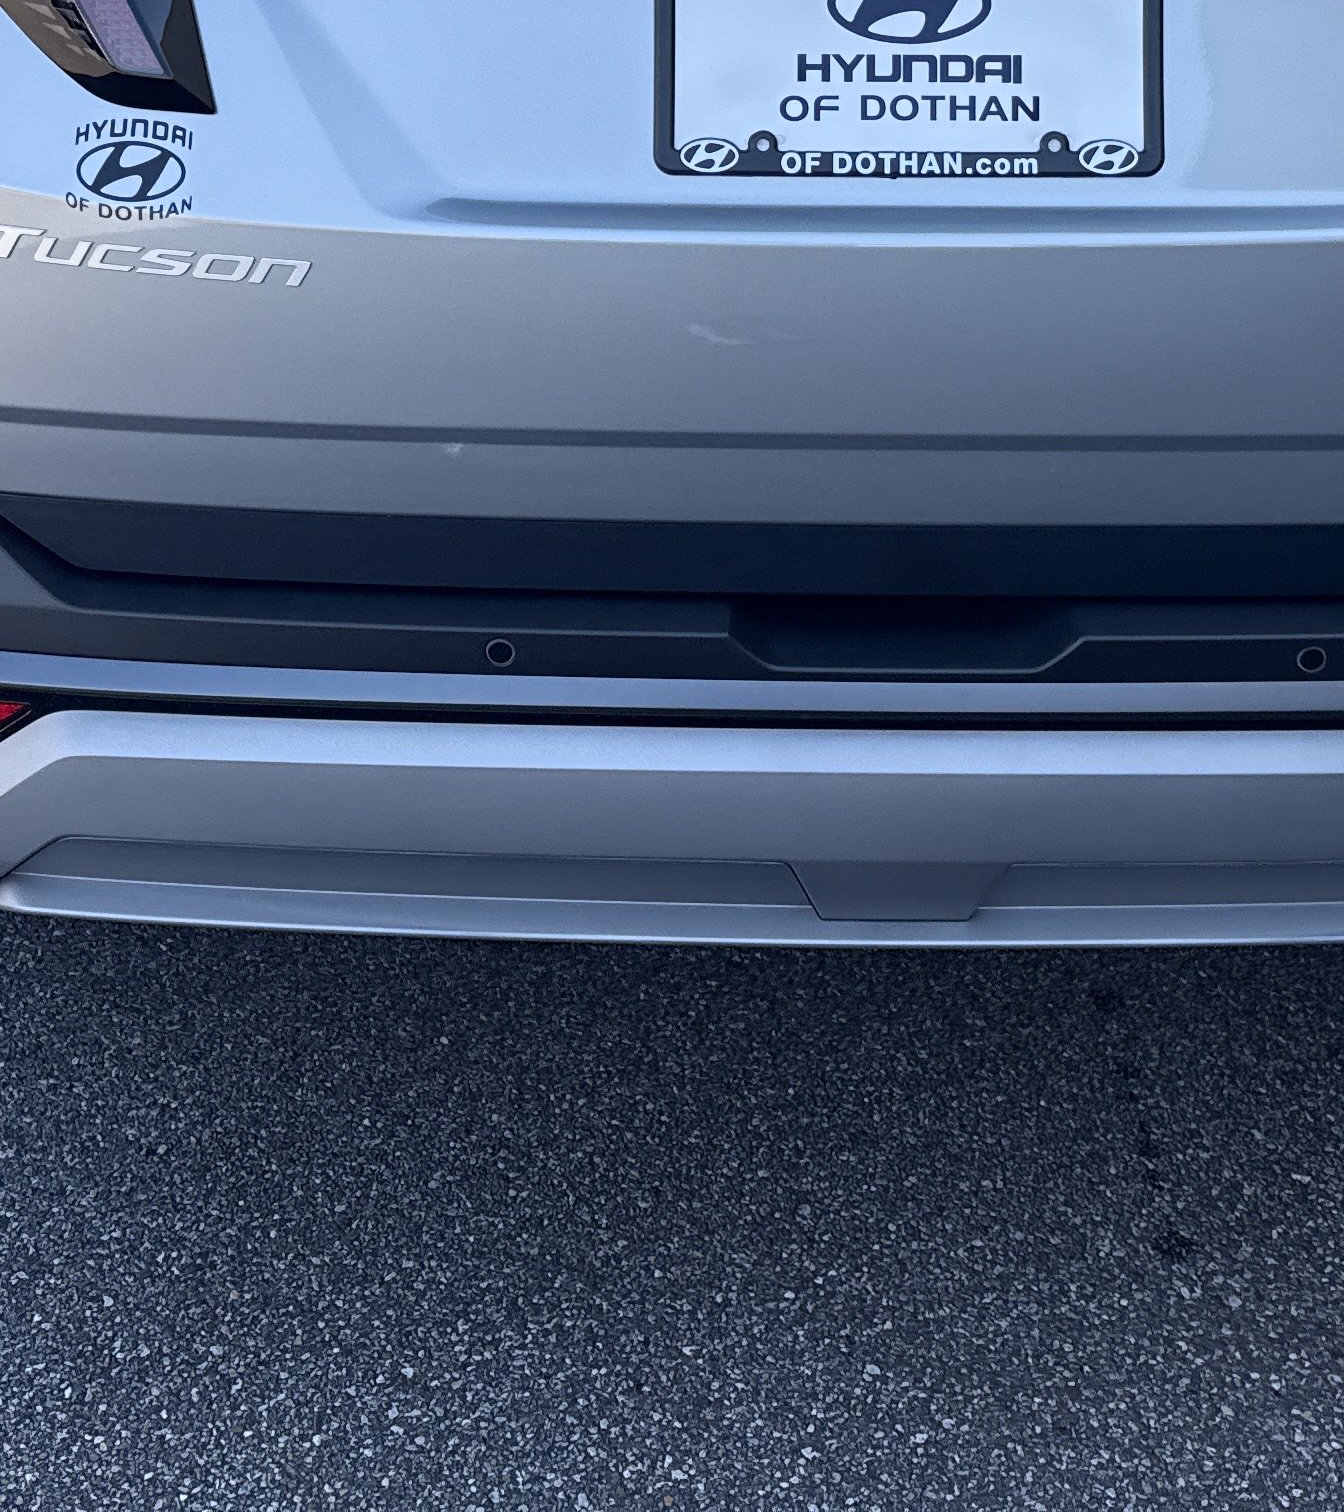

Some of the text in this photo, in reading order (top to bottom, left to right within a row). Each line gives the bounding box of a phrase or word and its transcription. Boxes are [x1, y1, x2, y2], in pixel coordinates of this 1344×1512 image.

[797, 54, 1022, 84] HYUNDAI
[779, 95, 1040, 122] OF DOTHAN
[75, 118, 194, 150] HYUNDAI
[780, 151, 1039, 175] OF DOTHAN.com
[65, 192, 193, 221] OF DOTHAN
